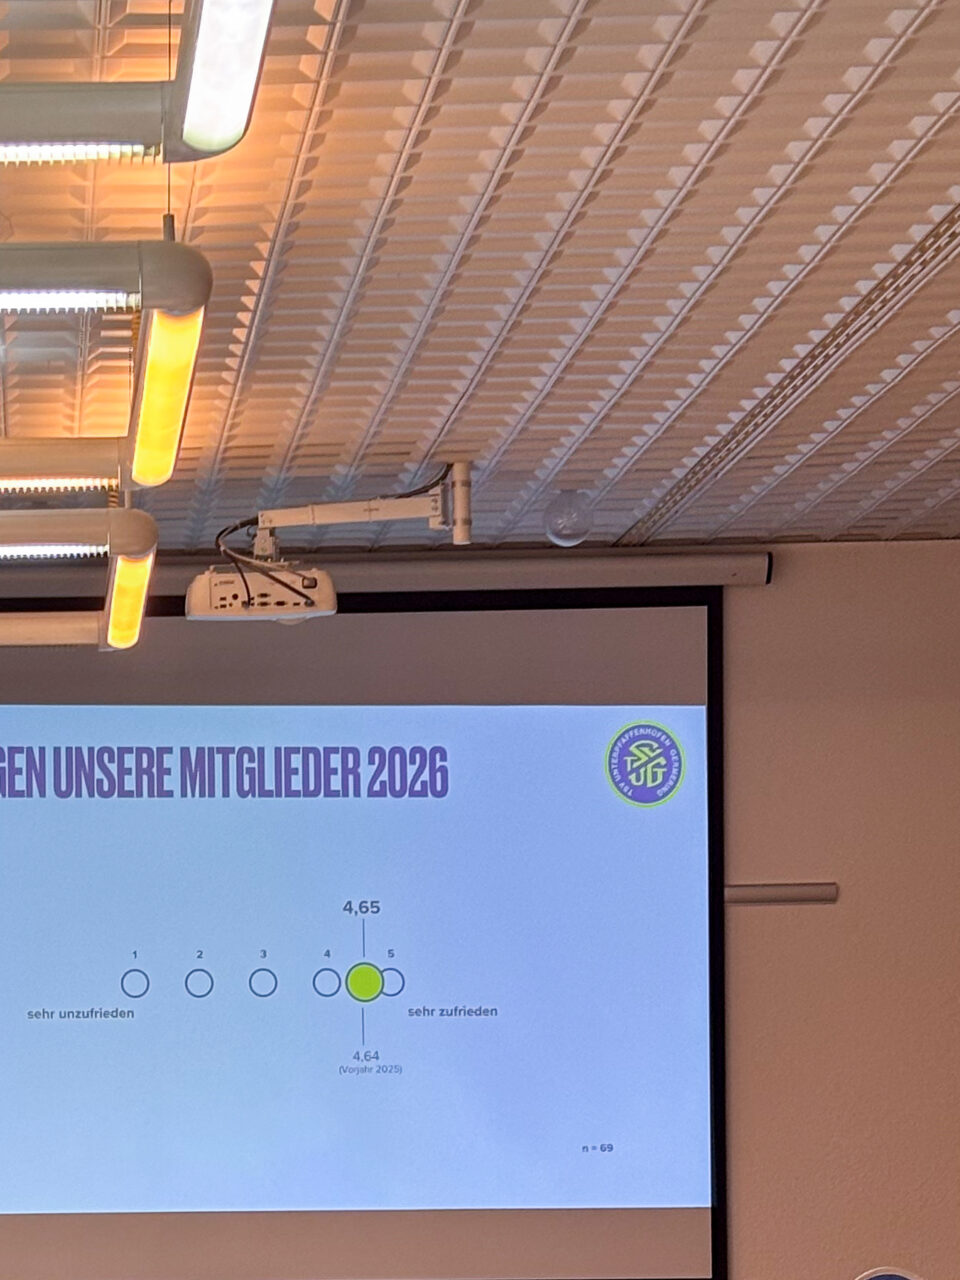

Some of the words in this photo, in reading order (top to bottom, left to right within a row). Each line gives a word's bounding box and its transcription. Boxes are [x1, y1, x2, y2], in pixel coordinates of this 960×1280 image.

[53, 746, 174, 799] UNSERE
[180, 746, 361, 799] MITGLIEDER
[367, 746, 449, 799] 2026
[342, 900, 380, 916] 4,65
[132, 950, 138, 959] 1
[196, 950, 203, 959] 2
[260, 950, 267, 959] 3
[323, 950, 331, 959] 4
[387, 949, 395, 958] 5
[27, 1008, 54, 1020] sehr
[58, 1007, 135, 1020] unzufrieden
[408, 1006, 436, 1017] sehr
[439, 1006, 498, 1017] zufrieden
[338, 1065, 373, 1075] (Vorjahr
[375, 1064, 403, 1075] 2025)
[600, 1143, 614, 1152] 69
